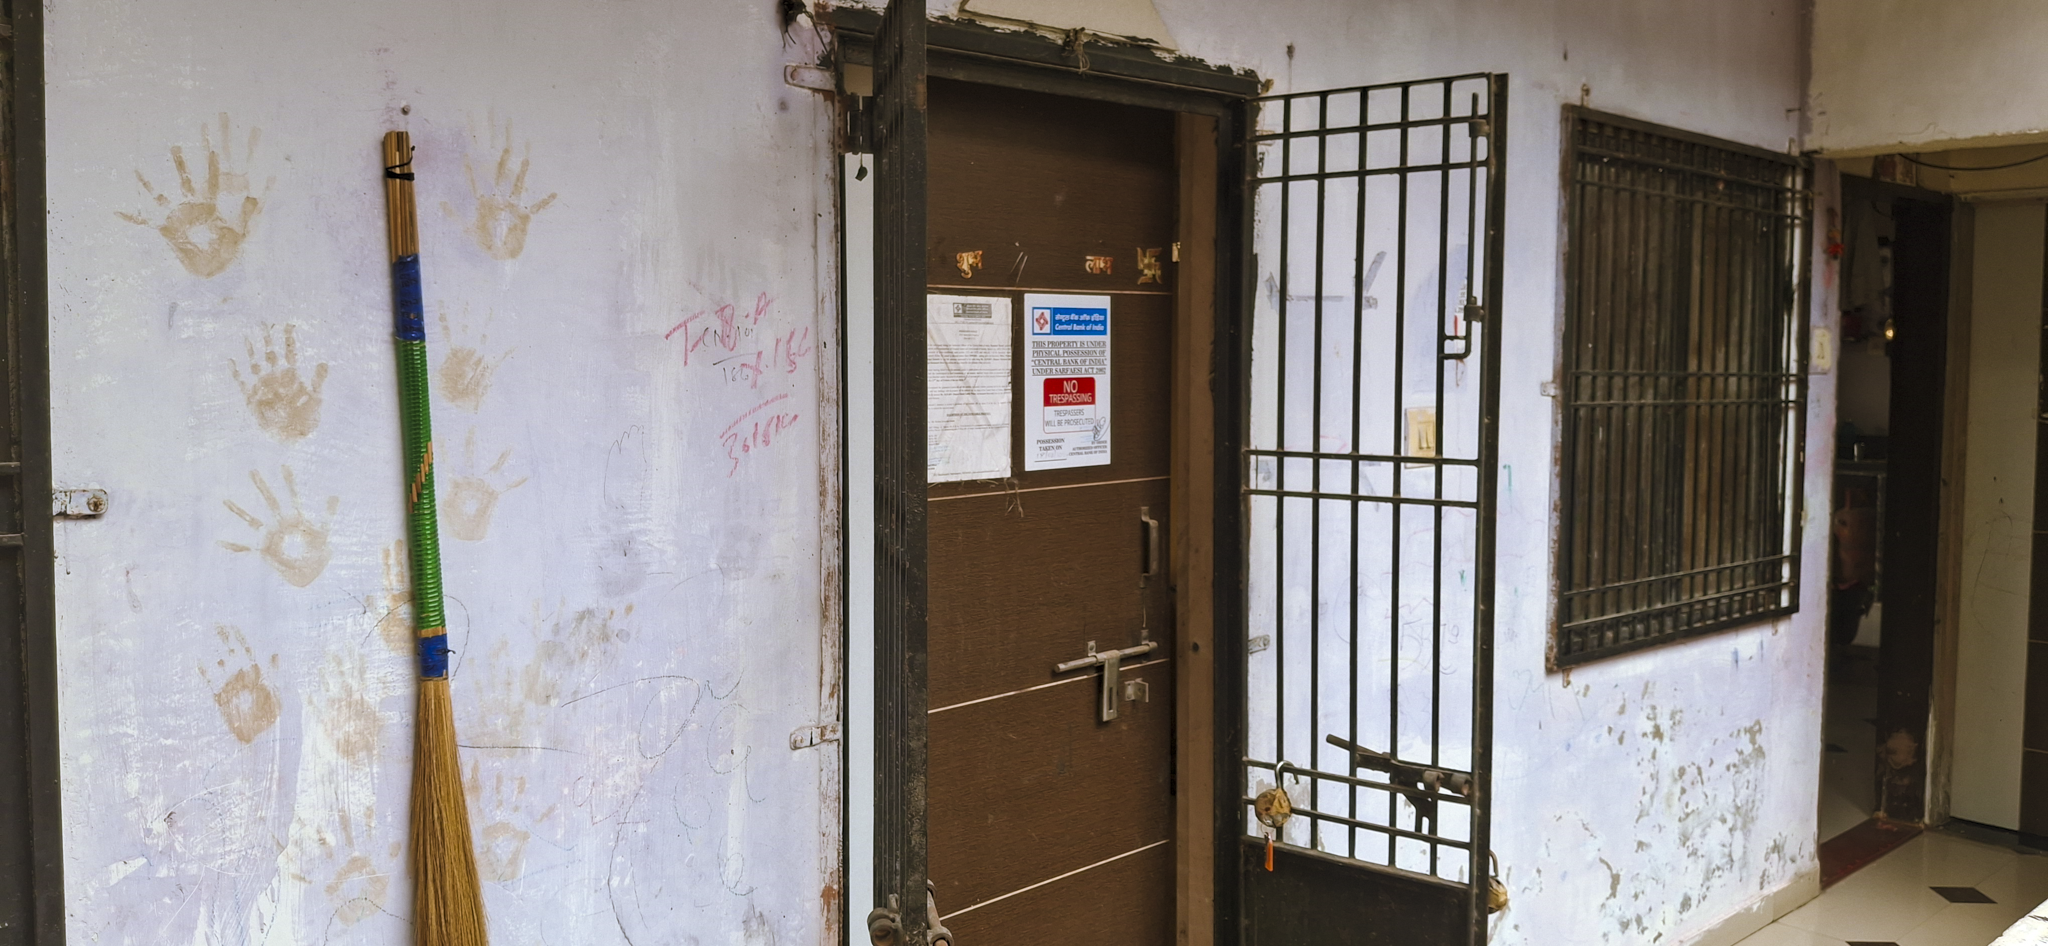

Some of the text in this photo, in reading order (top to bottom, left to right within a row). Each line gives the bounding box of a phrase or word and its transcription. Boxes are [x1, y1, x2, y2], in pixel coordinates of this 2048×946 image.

[956, 250, 983, 279] शुभ
[1085, 256, 1114, 274] लाभ
[1063, 380, 1078, 393] NO
[1049, 393, 1092, 404] TRESPASSING
[1064, 418, 1094, 426] PROSECUTED
